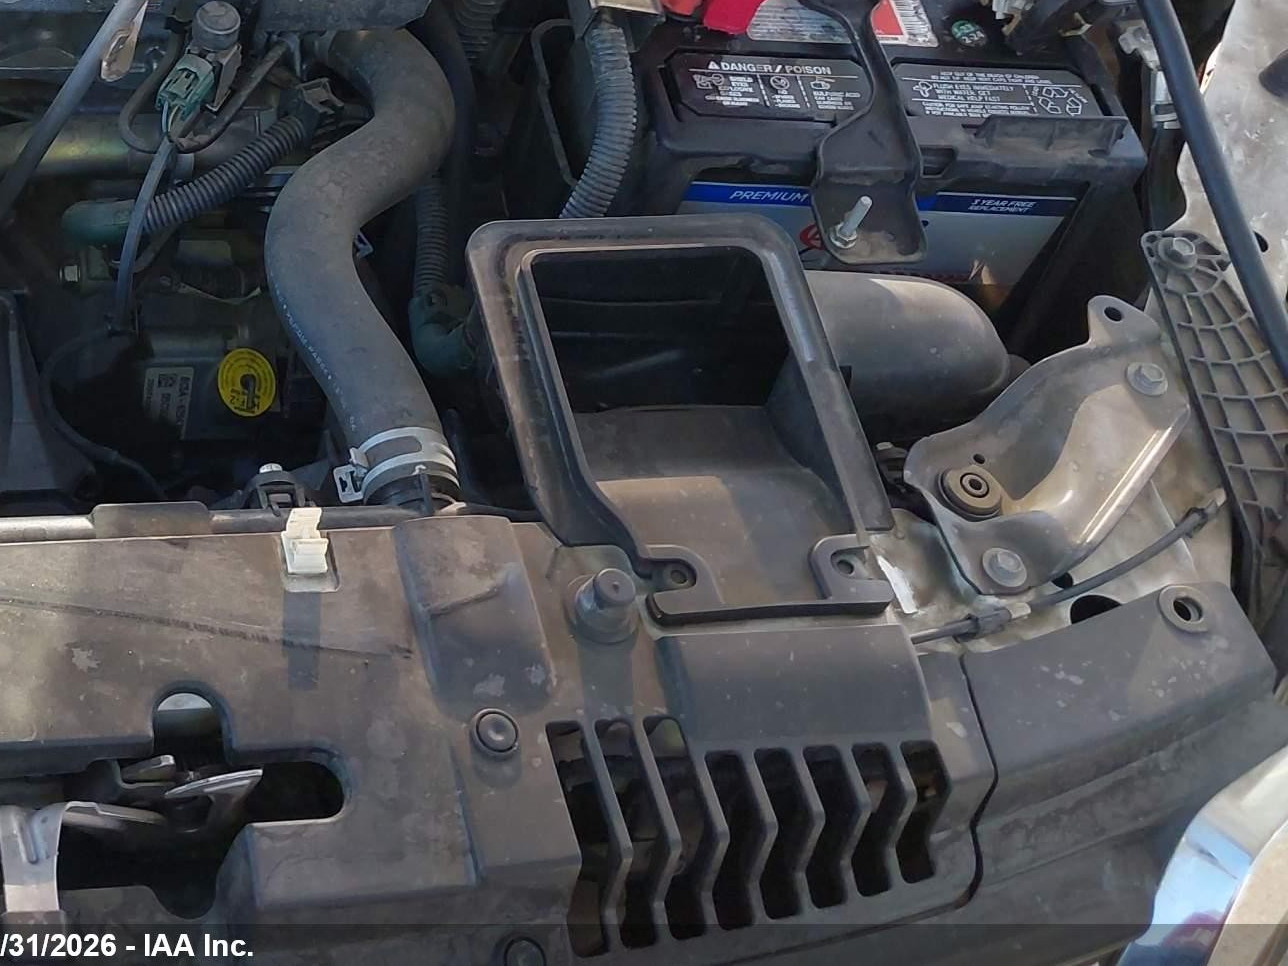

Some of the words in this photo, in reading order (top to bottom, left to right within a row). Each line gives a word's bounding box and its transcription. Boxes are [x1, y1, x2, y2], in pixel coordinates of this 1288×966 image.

[721, 62, 772, 73] DANGER
[785, 65, 832, 75] POISON
[729, 190, 809, 202] PREMIUM
[981, 199, 1008, 207] YEAR
[1007, 200, 1037, 208] FREE
[968, 205, 1030, 214] REPLACEMENT
